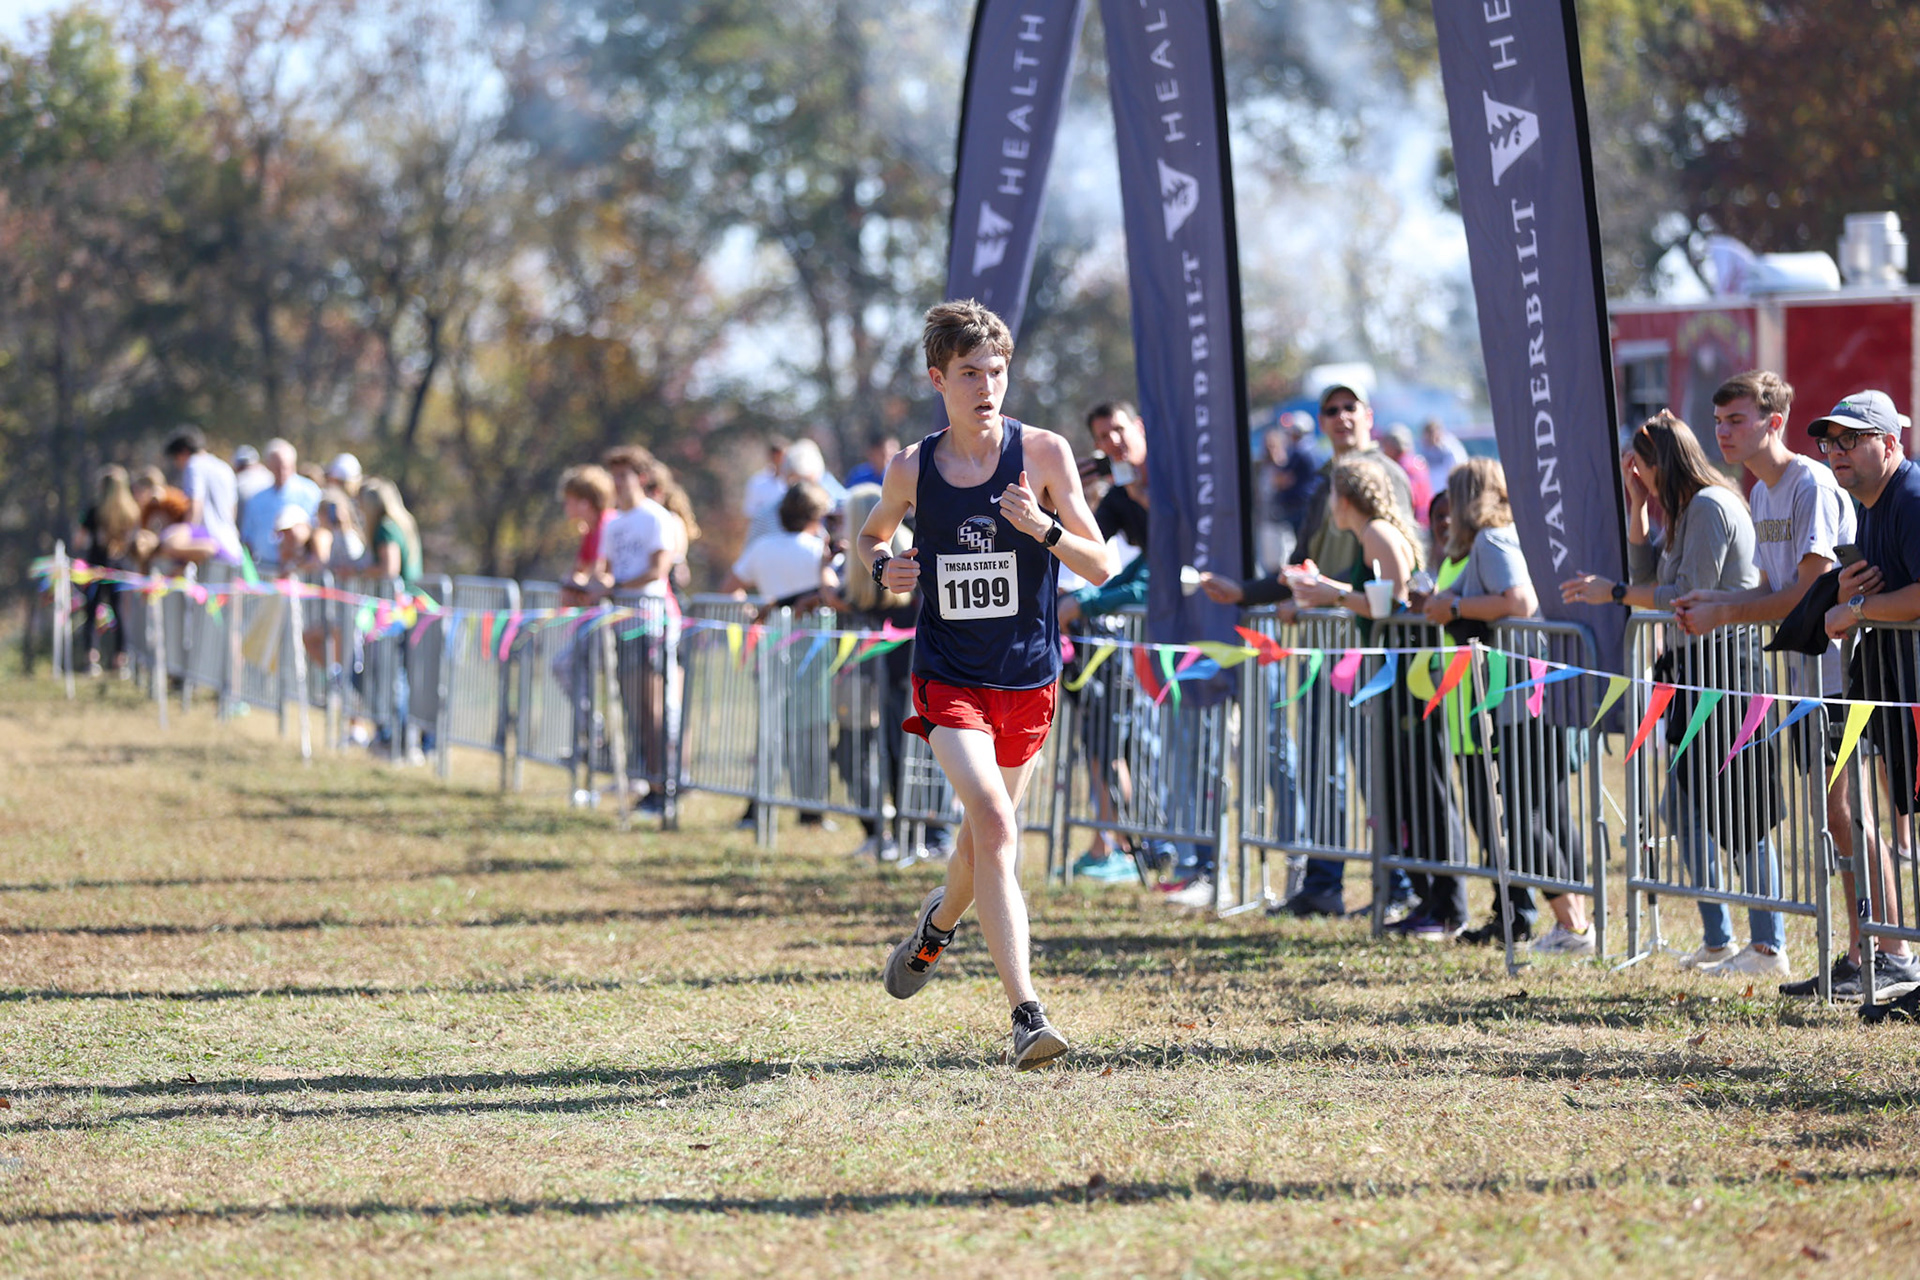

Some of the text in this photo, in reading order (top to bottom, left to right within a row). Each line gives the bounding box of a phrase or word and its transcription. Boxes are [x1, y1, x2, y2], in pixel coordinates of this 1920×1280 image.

[997, 14, 1046, 196] HEALTH
[1139, 0, 1187, 143] HEAL
[1510, 197, 1569, 569] VANDERBILT
[945, 560, 1009, 572] TMSAA STATE XC
[960, 526, 992, 553] SBA
[944, 577, 1010, 610] 1199
